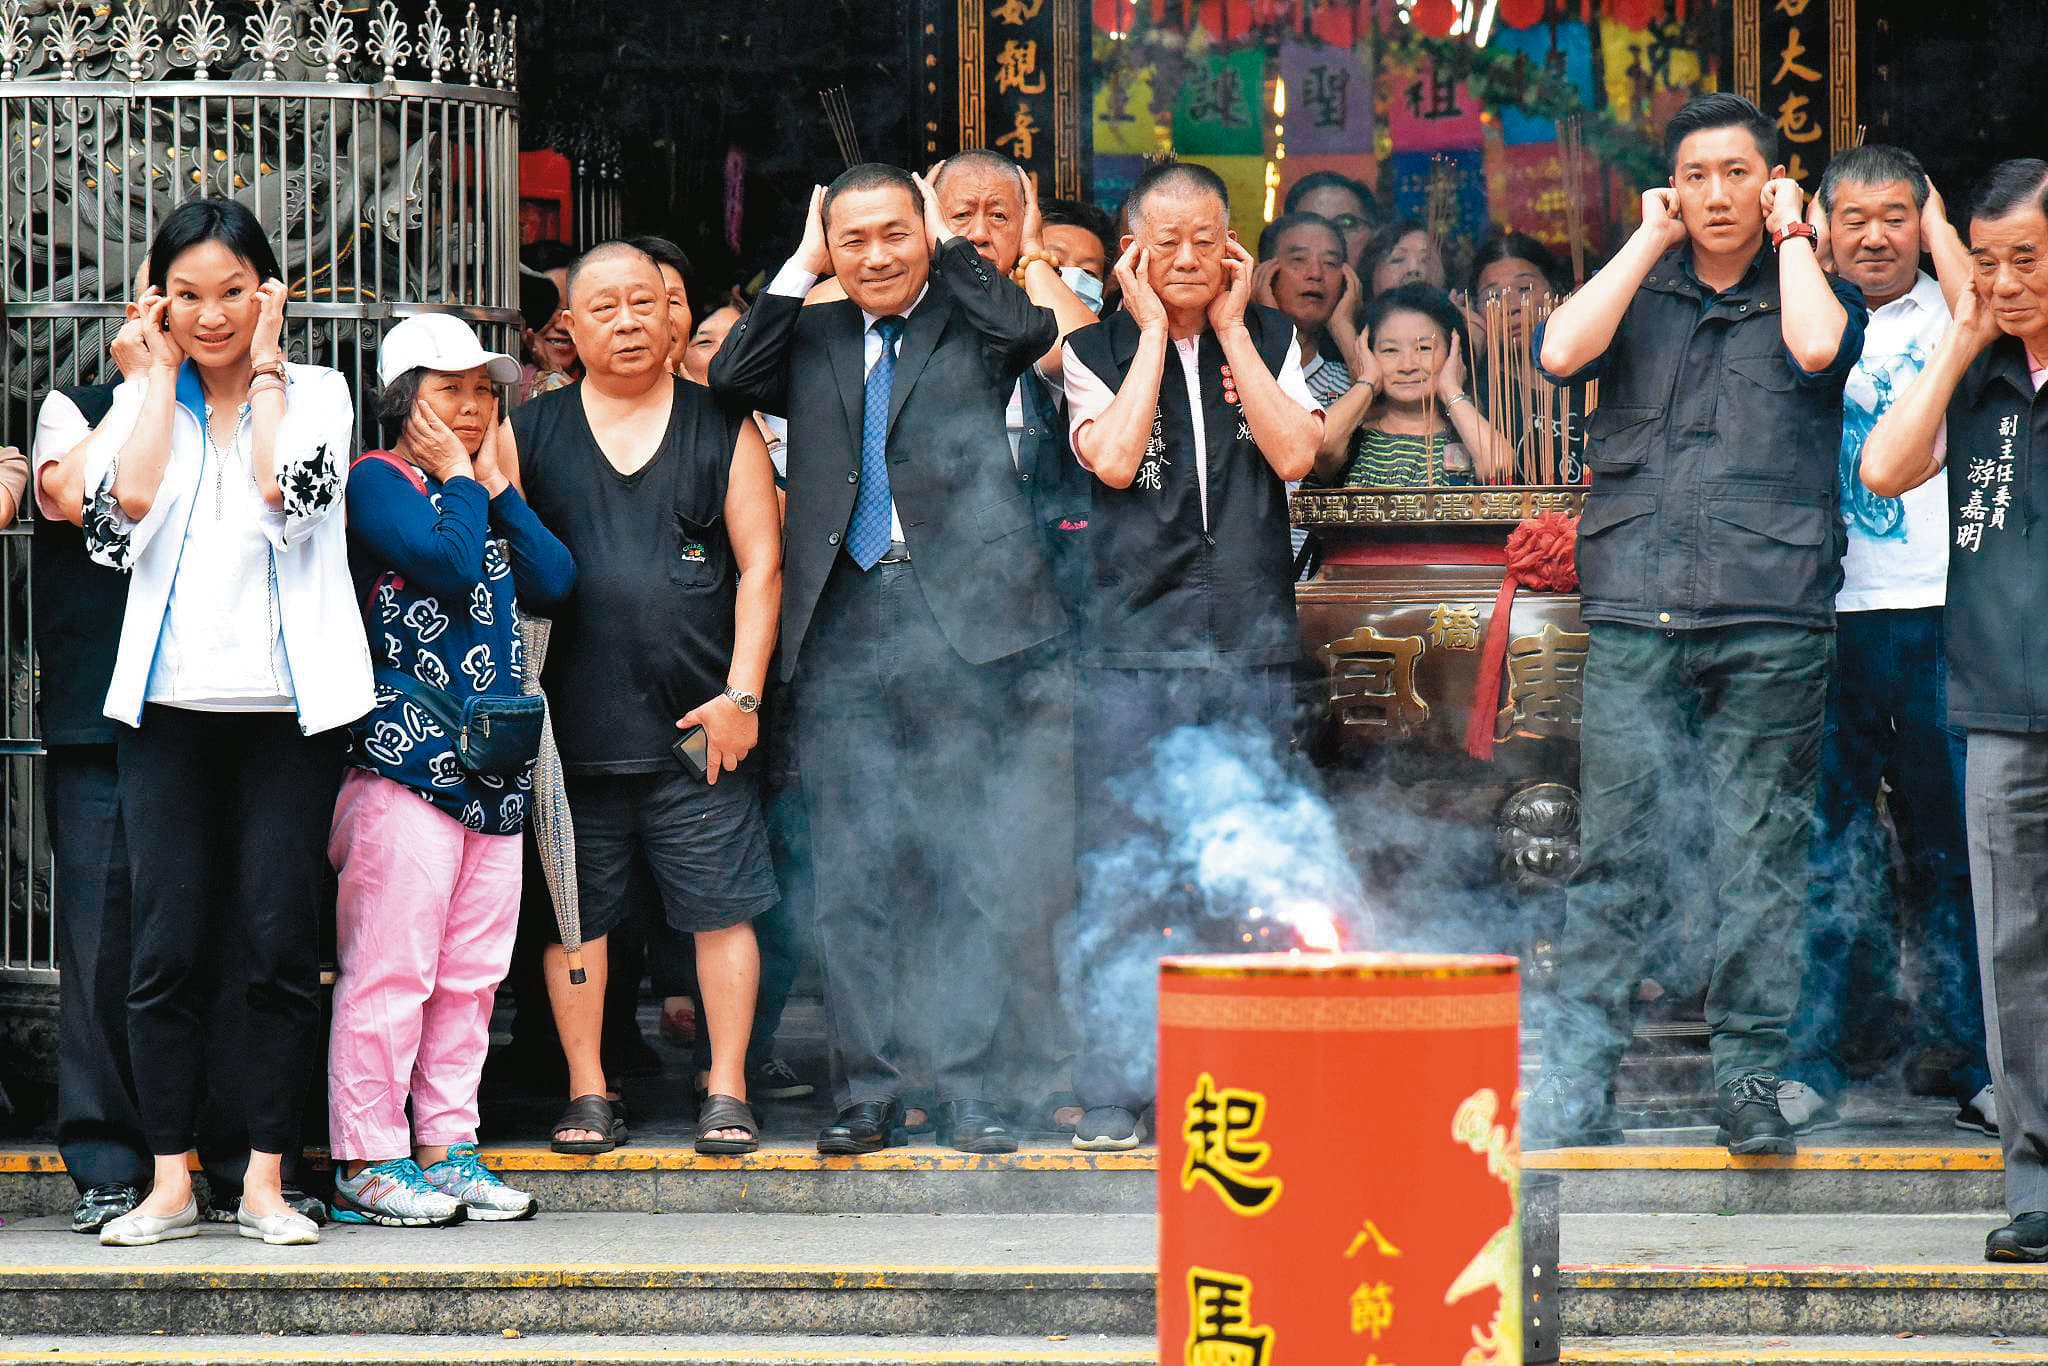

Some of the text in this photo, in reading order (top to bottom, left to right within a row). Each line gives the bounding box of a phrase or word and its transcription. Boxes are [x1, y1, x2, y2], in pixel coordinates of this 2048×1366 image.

[992, 0, 1046, 185] 觀音
[1956, 456, 1997, 553] 游嘉明
[1989, 414, 2018, 530] 副主任委員
[1344, 1219, 1402, 1366] 八節
